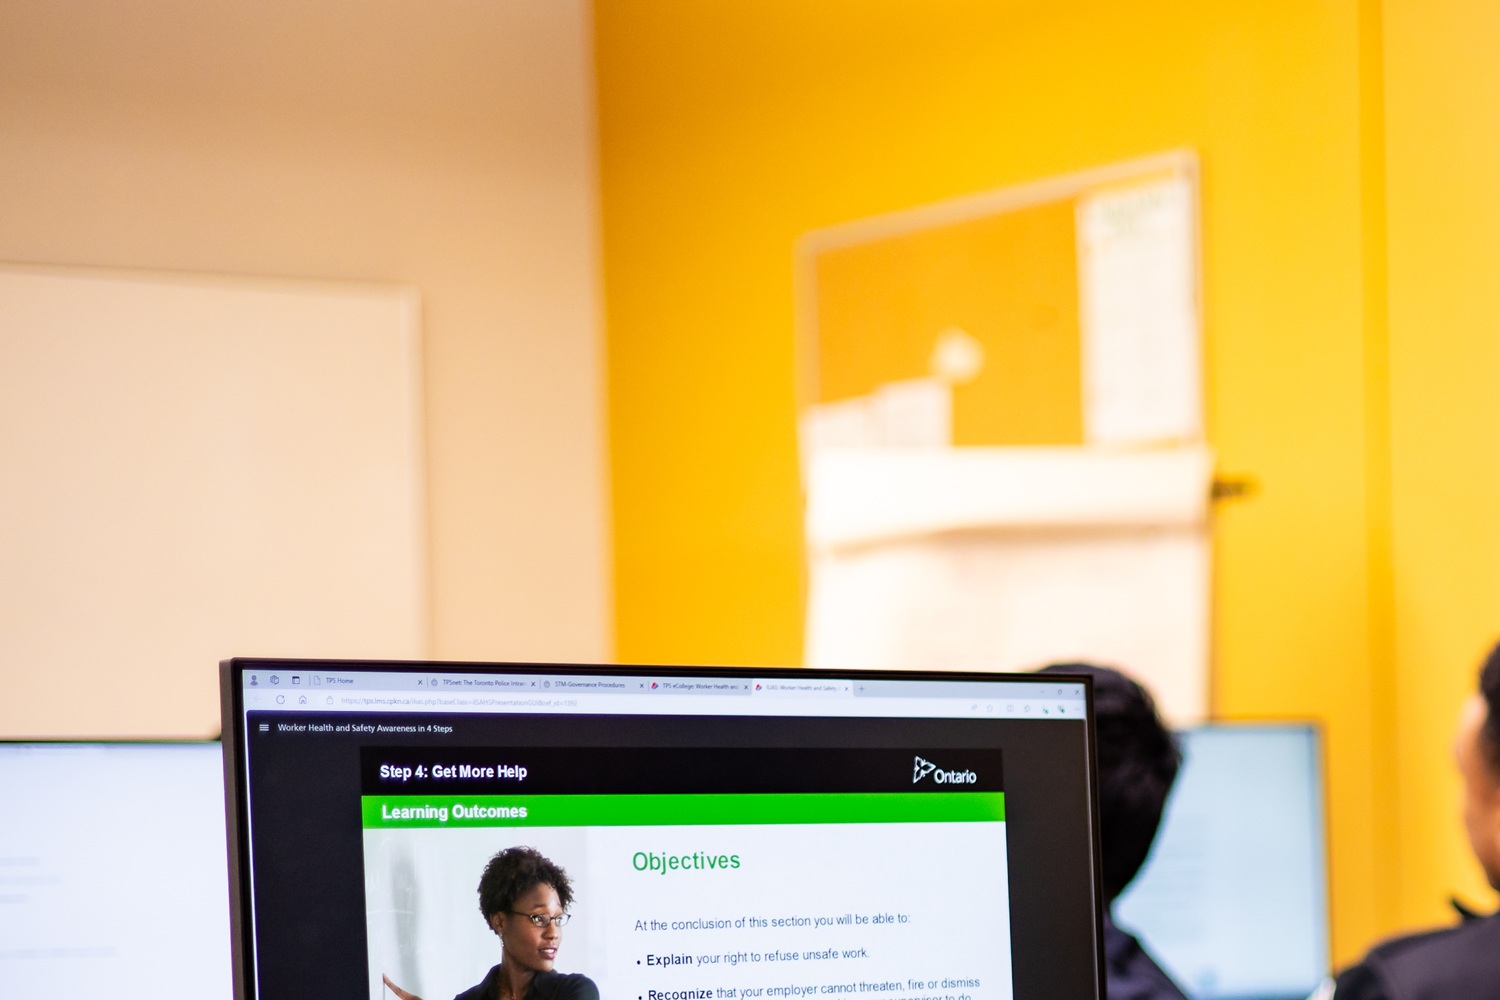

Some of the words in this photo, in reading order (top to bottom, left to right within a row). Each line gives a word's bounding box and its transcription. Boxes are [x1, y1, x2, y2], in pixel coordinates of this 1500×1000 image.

[474, 679, 494, 687] Toronto
[278, 723, 306, 732] Worker
[308, 723, 334, 732] Health
[336, 723, 350, 732] and
[352, 723, 375, 734] Safety
[377, 724, 416, 733] Awareness
[418, 724, 425, 733] in
[426, 724, 432, 732] 4
[433, 724, 453, 734] Steps
[380, 764, 412, 781] Step
[415, 765, 428, 779] 4:
[432, 764, 457, 779] Get
[459, 764, 494, 779] More
[497, 764, 528, 781] Help
[933, 769, 977, 784] Ontario
[381, 804, 448, 821] Learning
[452, 804, 528, 819] Outcomes
[632, 851, 741, 875] Objectives
[634, 919, 648, 931] At
[650, 918, 668, 931] the
[671, 917, 732, 930] conclusion
[734, 917, 746, 929] of
[748, 916, 768, 928] this
[771, 915, 811, 927] section
[814, 916, 834, 929] you
[836, 913, 852, 926] will
[855, 913, 869, 925] be
[872, 913, 894, 925] able
[897, 913, 911, 924] to:
[647, 953, 693, 968] Explain
[696, 953, 721, 967] your
[723, 951, 748, 966] right
[750, 951, 762, 963] to
[764, 949, 799, 962] refuse
[802, 948, 839, 961] unsafe
[842, 947, 870, 959] work.
[716, 986, 737, 999] that
[739, 986, 764, 1000] your
[766, 983, 817, 998] employer
[820, 981, 857, 994] cannot
[859, 980, 905, 994] threaten,
[907, 978, 925, 990] fire
[927, 979, 939, 990] or
[941, 976, 981, 989] dismiss
